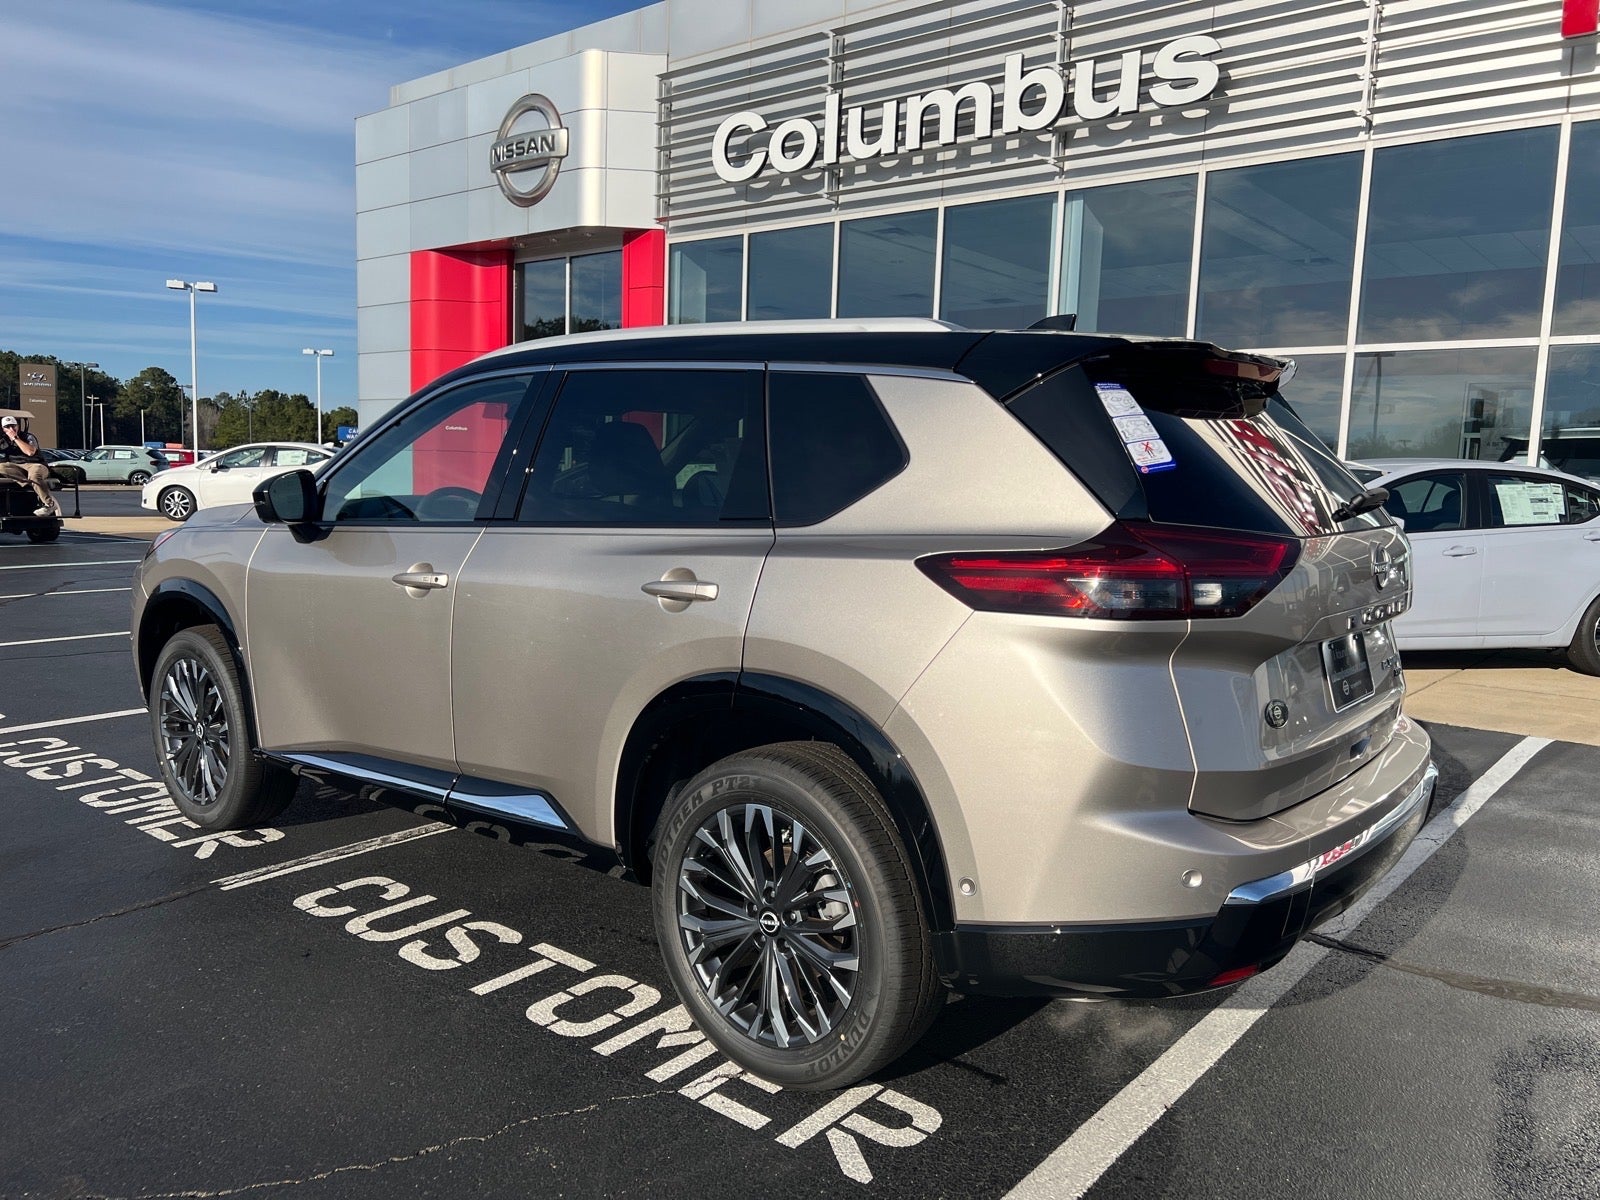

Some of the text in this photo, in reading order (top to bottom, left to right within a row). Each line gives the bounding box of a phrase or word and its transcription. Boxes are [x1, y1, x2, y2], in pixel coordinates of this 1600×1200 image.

[492, 134, 556, 165] NISSAN
[712, 35, 1222, 183] Columbus
[0, 737, 286, 860] CUSTOMER
[292, 875, 943, 1185] CUSTOMER
[804, 1006, 871, 1078] DUNLOP
